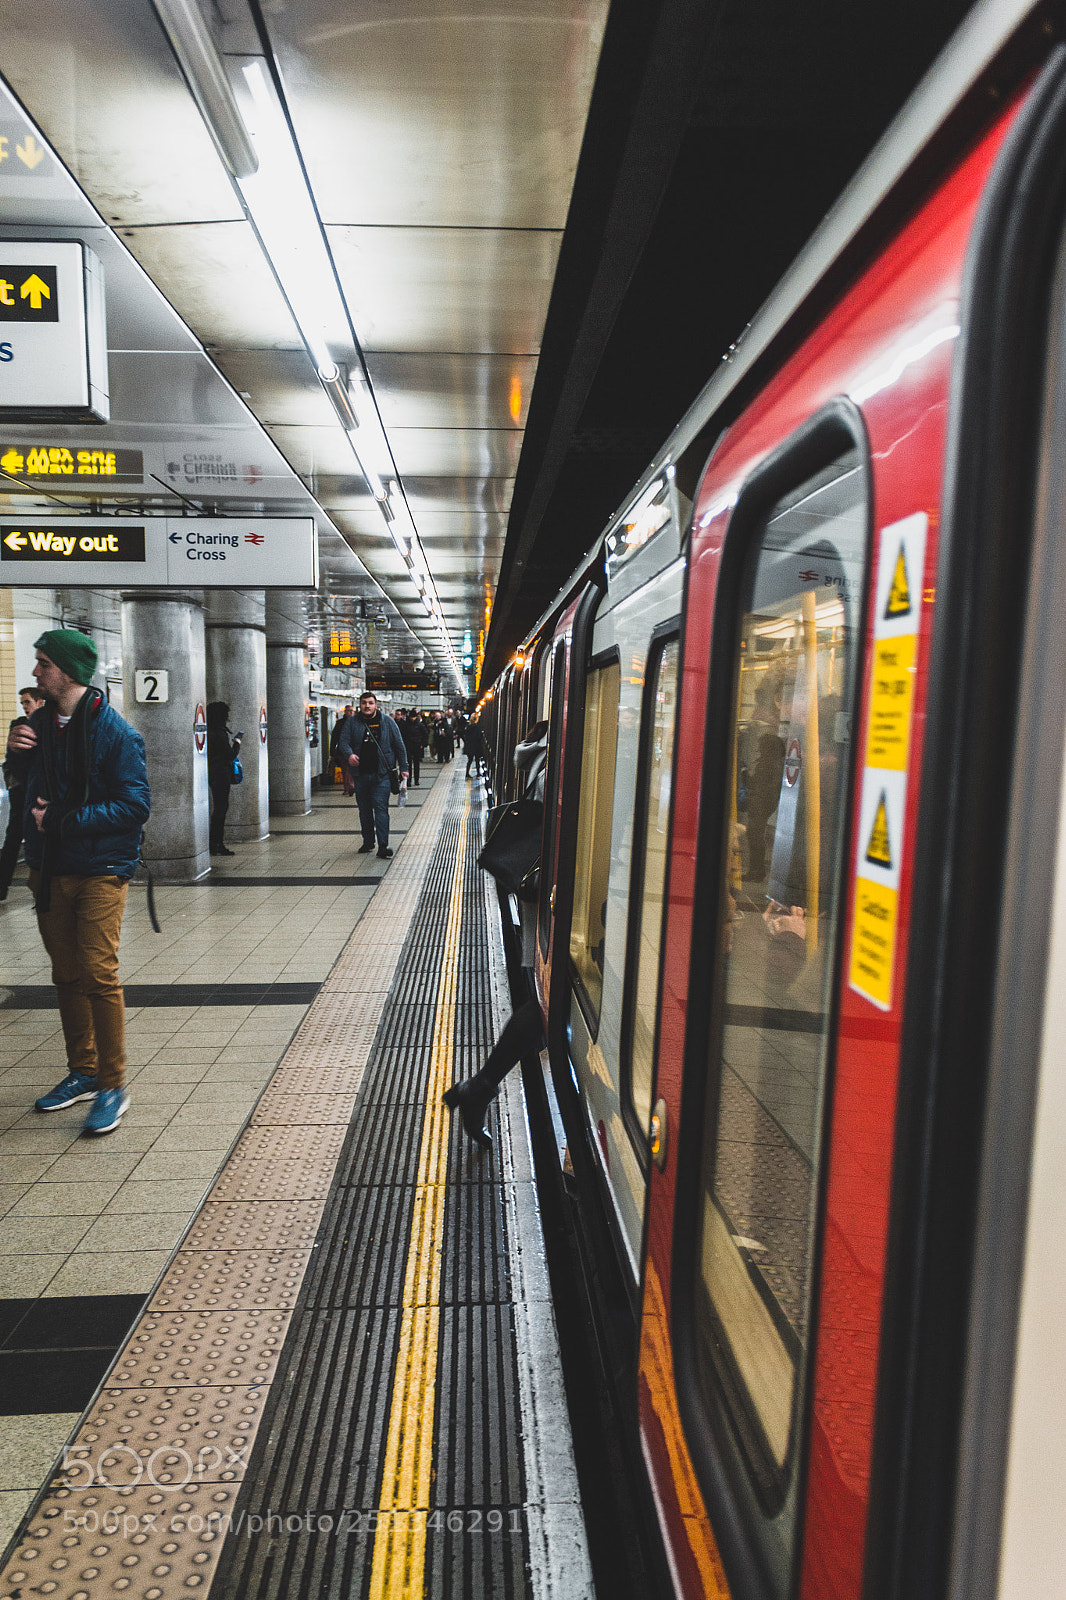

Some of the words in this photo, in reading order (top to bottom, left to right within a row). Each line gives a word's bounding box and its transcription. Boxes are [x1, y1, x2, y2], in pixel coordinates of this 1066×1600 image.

[28, 532, 77, 556] Way
[79, 534, 119, 552] out
[186, 532, 239, 547] Charing
[186, 548, 226, 560] Cross
[143, 675, 160, 701] 2
